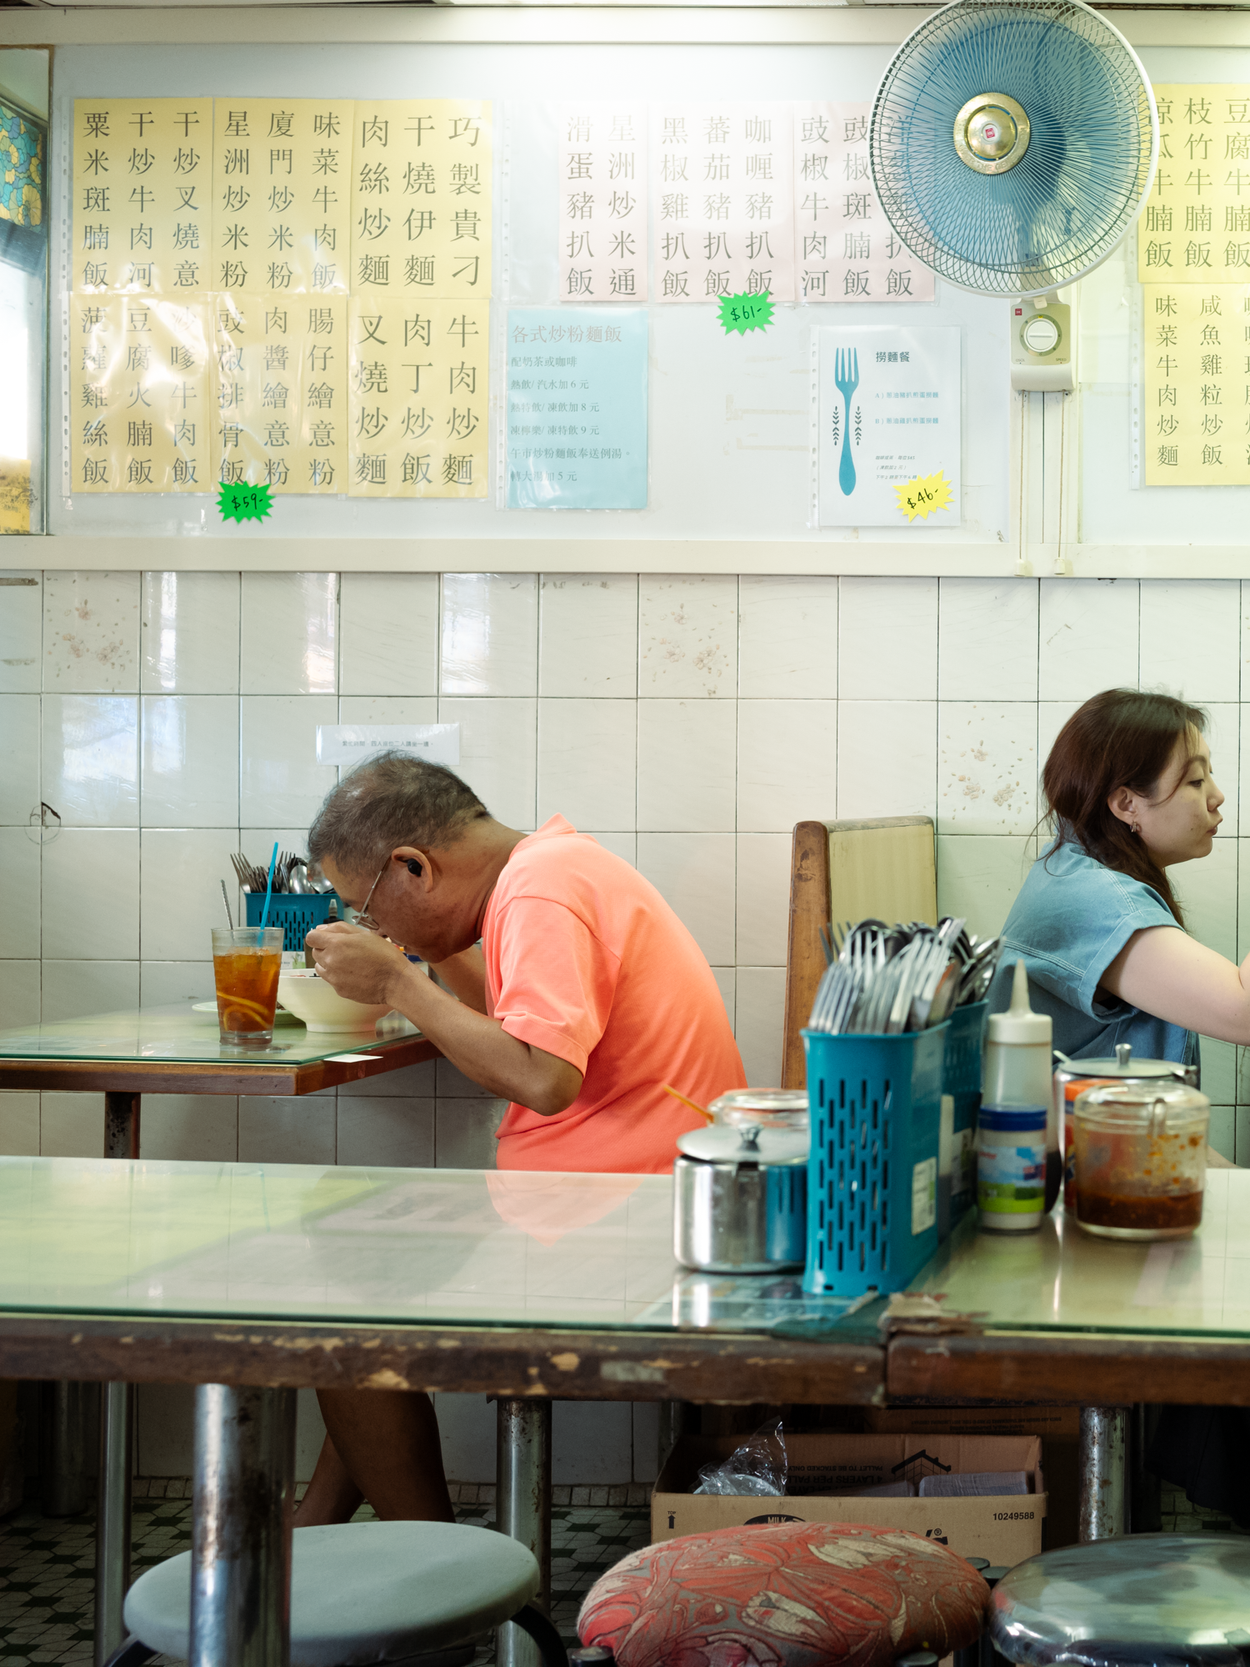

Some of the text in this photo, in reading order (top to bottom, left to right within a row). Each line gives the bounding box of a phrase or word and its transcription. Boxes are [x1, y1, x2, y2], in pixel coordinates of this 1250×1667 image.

[82, 110, 110, 288] 粟米斑腩飯
[128, 110, 156, 288] 干炒牛肉河
[173, 110, 200, 288] 干炒叉燒意
[220, 110, 251, 288] 星洲炒米粉
[311, 110, 340, 288] 味菜牛肉飯
[358, 114, 391, 288] 肉絲炒麵
[402, 114, 436, 288] 干燒伊麵
[448, 114, 481, 288] 巧製貴刁
[566, 116, 595, 296] 滑蛋豬扒飯
[607, 116, 637, 296] 星洲炒米通
[660, 116, 691, 296] 黑椒雞扒飯
[702, 116, 733, 296] 蕃茄豬扒飯
[744, 116, 775, 296] 咖喱豬扒飯
[800, 116, 830, 296] 豉椒牛肉河
[842, 116, 872, 296] 豉椒斑腩飯
[1183, 97, 1213, 268] 枝竹牛腩飯
[125, 306, 154, 486] 豆腐火腩飯
[217, 306, 245, 486] 豉椒排骨飯
[262, 306, 290, 486] 肉醬繪意粉
[307, 306, 336, 486] 腸仔繪意粉
[355, 313, 389, 487] 叉燒炒麵
[399, 313, 434, 487] 肉丁炒飯
[441, 313, 479, 487] 牛肉炒麵
[511, 325, 622, 343] 各式炒粉麵飯
[511, 356, 577, 368] 配奶茶或咖啡
[875, 351, 910, 363] 撈麵餐
[1155, 294, 1180, 466] 味菜牛肉炒麵
[1200, 294, 1224, 466] 咸魚雞粒炒飯
[992, 1511, 1035, 1522] 10249588
